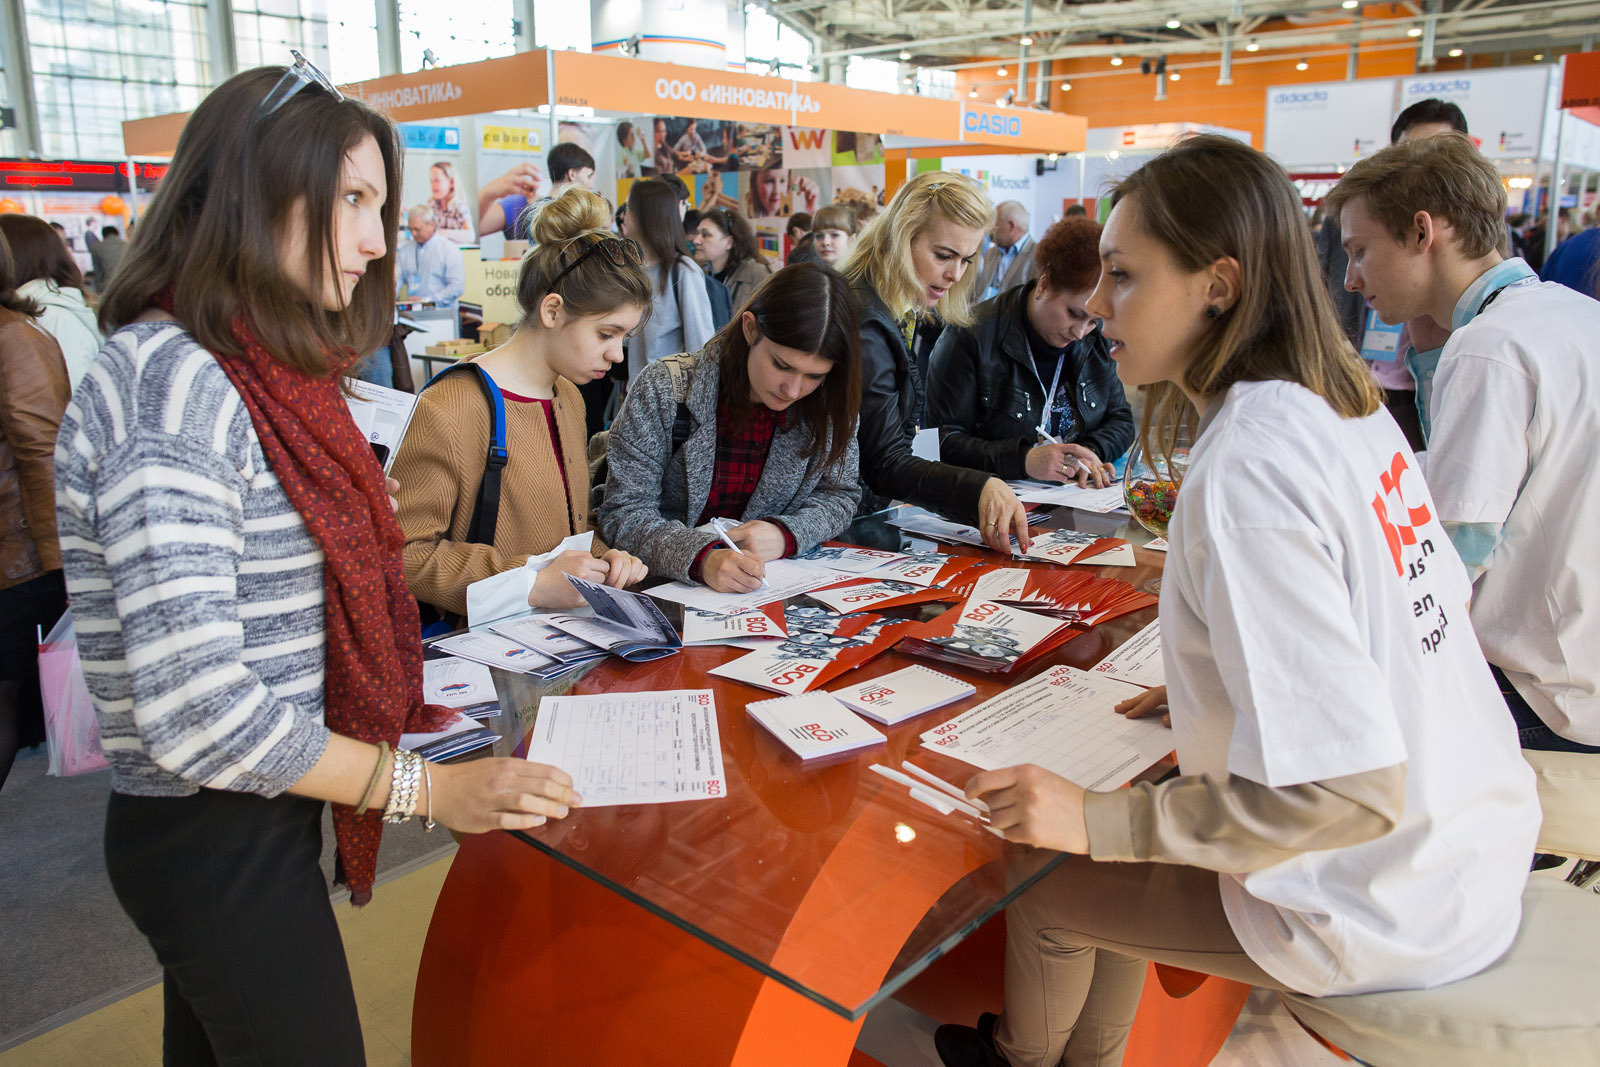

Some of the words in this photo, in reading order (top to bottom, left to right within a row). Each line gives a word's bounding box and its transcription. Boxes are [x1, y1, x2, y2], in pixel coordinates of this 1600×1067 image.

[654, 77, 697, 101] ООО
[700, 83, 821, 113] «ИННОВАТИКА»
[964, 111, 1022, 137] CASIO
[407, 128, 456, 144] uboro
[482, 128, 538, 145] cuboro
[991, 174, 1031, 191] Microsoft
[484, 268, 518, 280] Нова
[485, 284, 518, 298] обра
